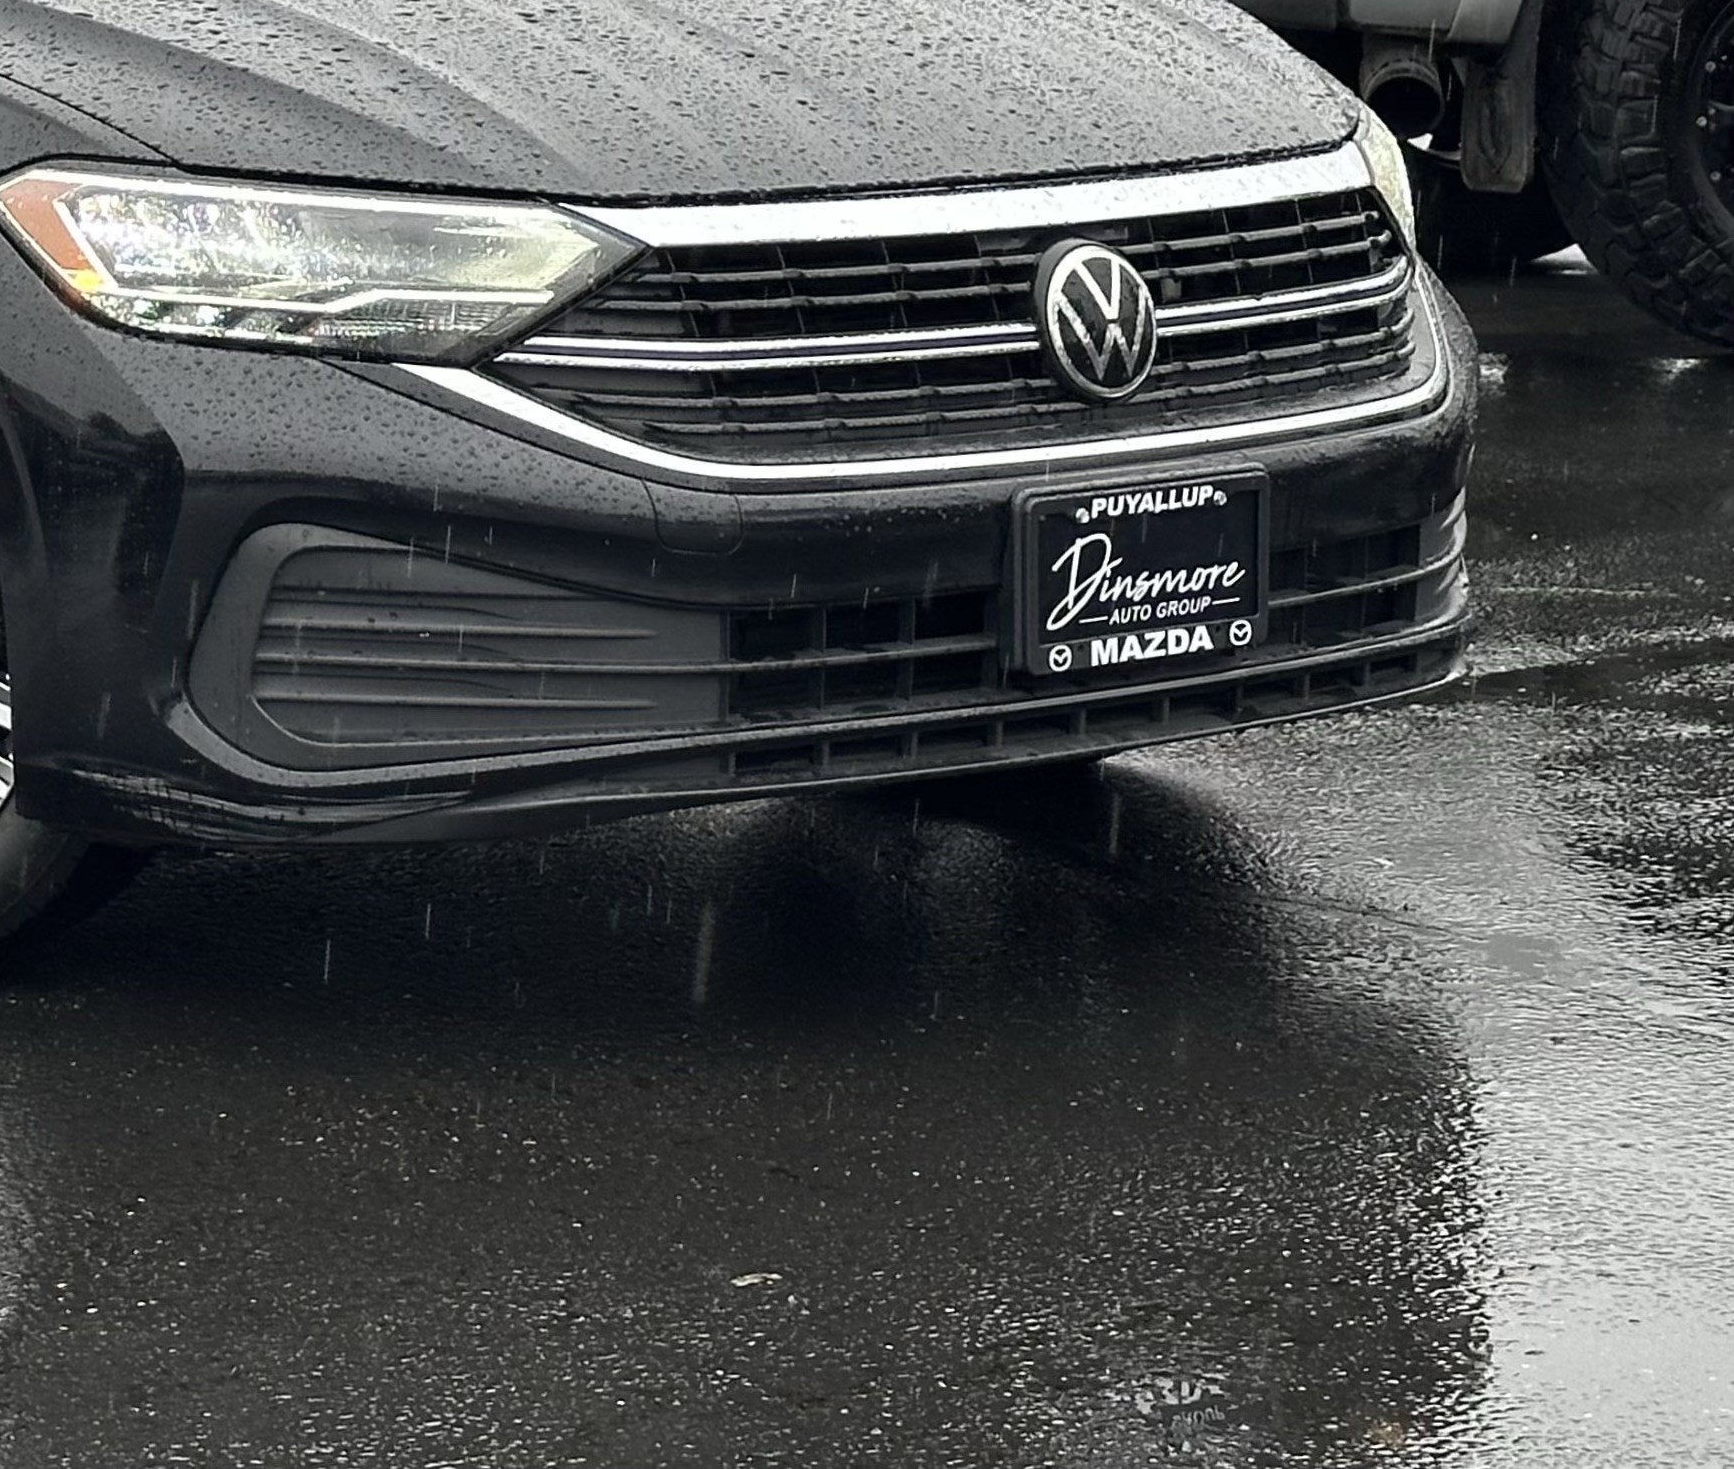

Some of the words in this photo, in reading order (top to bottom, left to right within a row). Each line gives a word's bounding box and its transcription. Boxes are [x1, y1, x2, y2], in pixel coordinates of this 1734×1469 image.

[1090, 485, 1213, 519] PUYALLUP
[1046, 533, 1245, 630] Dinsmore
[1109, 605, 1151, 625] AUTO
[1156, 596, 1211, 618] GROUP
[1090, 625, 1214, 666] MAZDA
